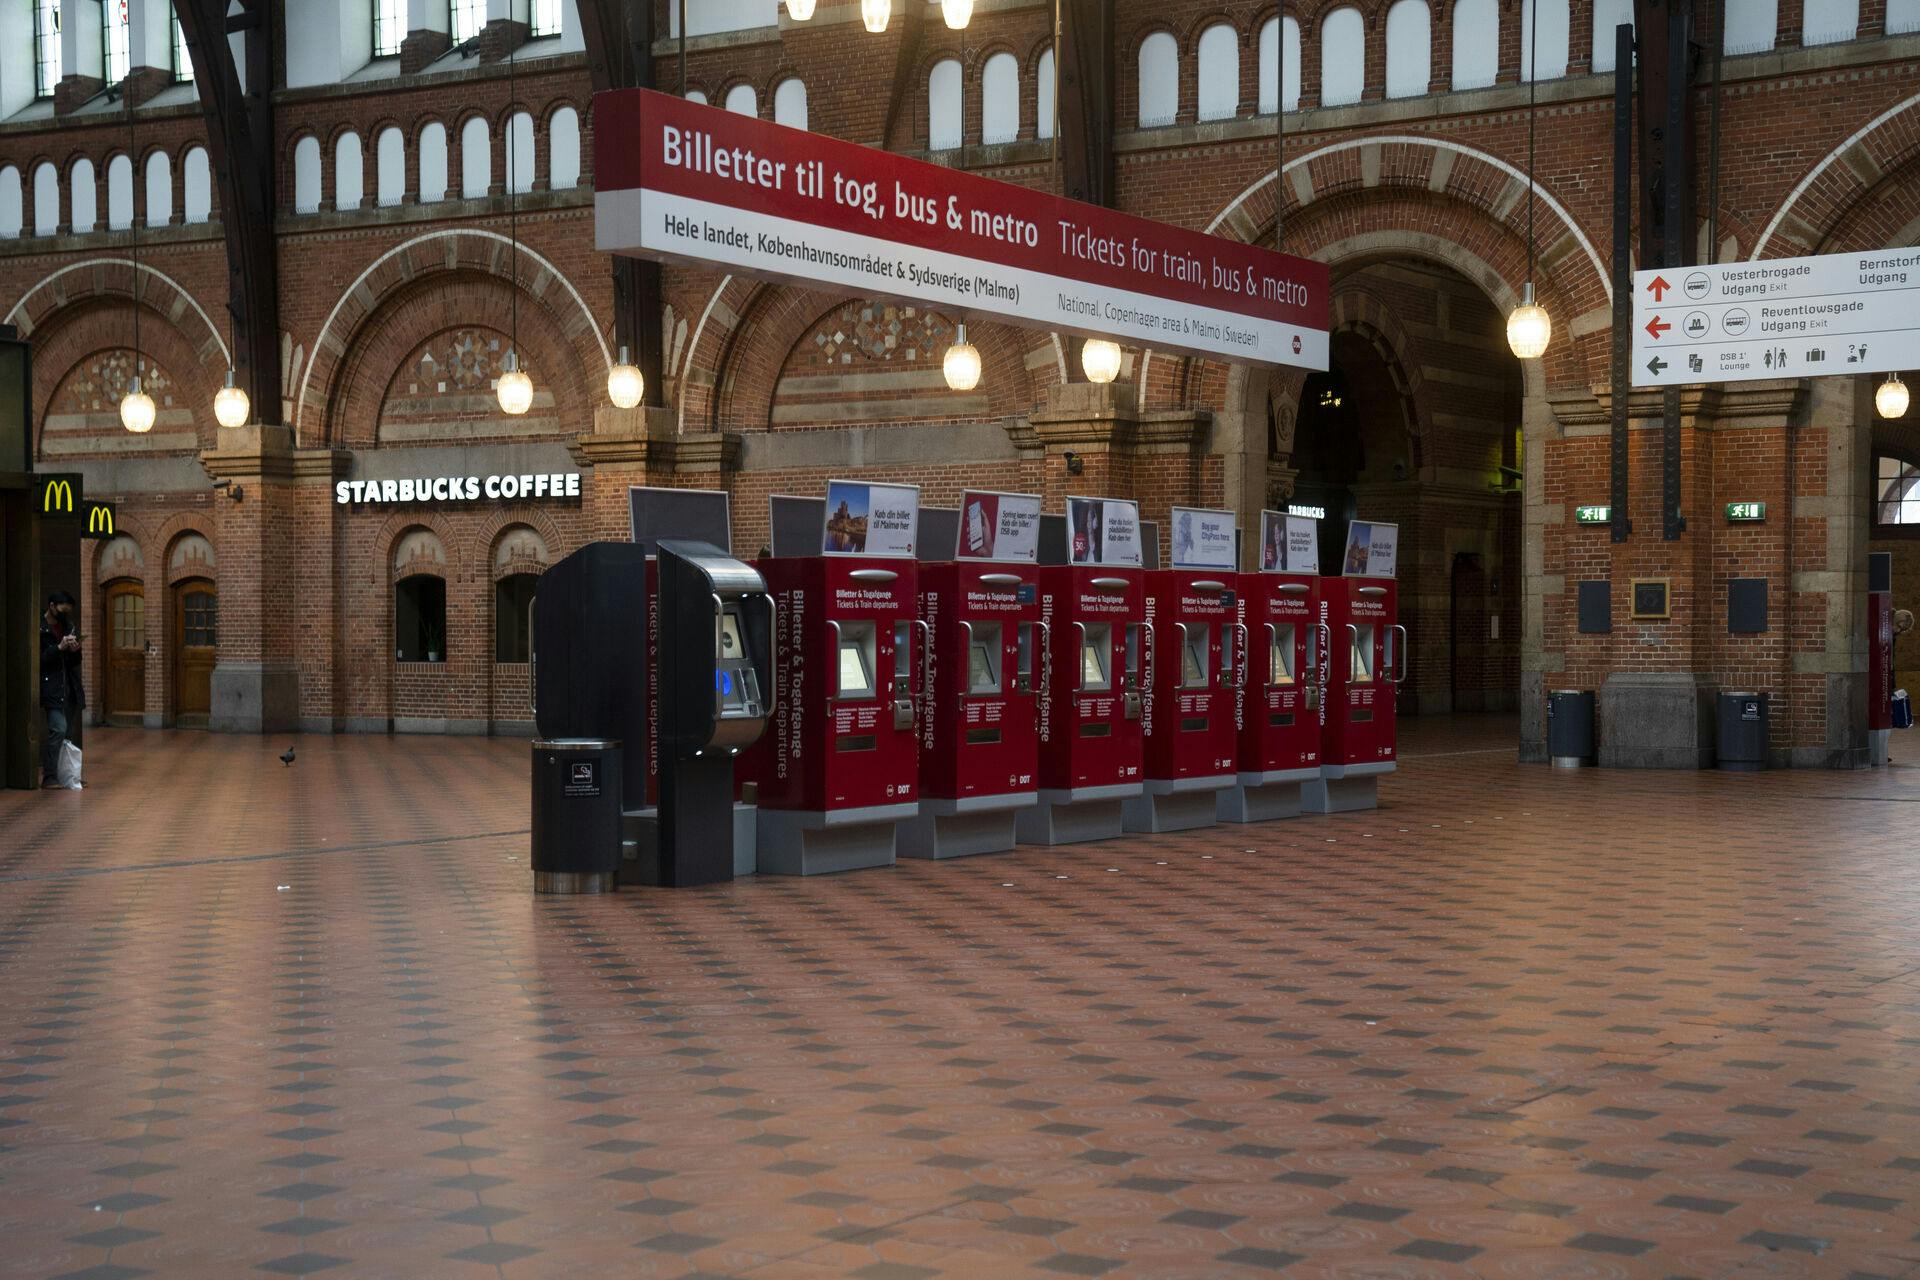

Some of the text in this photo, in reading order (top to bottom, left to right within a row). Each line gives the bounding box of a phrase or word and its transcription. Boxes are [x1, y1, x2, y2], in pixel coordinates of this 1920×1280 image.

[663, 125, 1038, 247] Billetter til tog, bus & metro
[665, 214, 1020, 306] Hele landet, Københavnsområdet & Sydsverige (Malmø)
[1058, 221, 1308, 307] Tickets for train, bus & metro
[1722, 265, 1810, 281] Vesterbrogade
[1860, 273, 1906, 284] Udgang
[1722, 282, 1787, 296] Udgang Exit
[1761, 301, 1864, 318] Reventlowsgade
[1058, 292, 1101, 320] National,
[1104, 302, 1160, 329] Copenhagen
[1162, 316, 1181, 333] area
[1183, 318, 1190, 334] &
[1222, 325, 1259, 349] (Sweden)
[1761, 318, 1828, 332] Udgang Exit
[1720, 352, 1736, 361] DSB
[1720, 362, 1750, 371] Lounge
[336, 473, 580, 504] STARBUCKS COFFEE
[874, 509, 885, 519] Køb
[887, 510, 895, 519] din
[1288, 504, 1325, 519] TARBUCKS
[900, 521, 910, 530] her
[836, 590, 857, 598] Billetter
[791, 590, 804, 758] Billetter & Togafgange
[924, 592, 938, 750] Billetter & Togafgange
[777, 590, 789, 779] Tickets & Train departures
[1019, 775, 1031, 784] DOT
[898, 784, 910, 794] DOT
